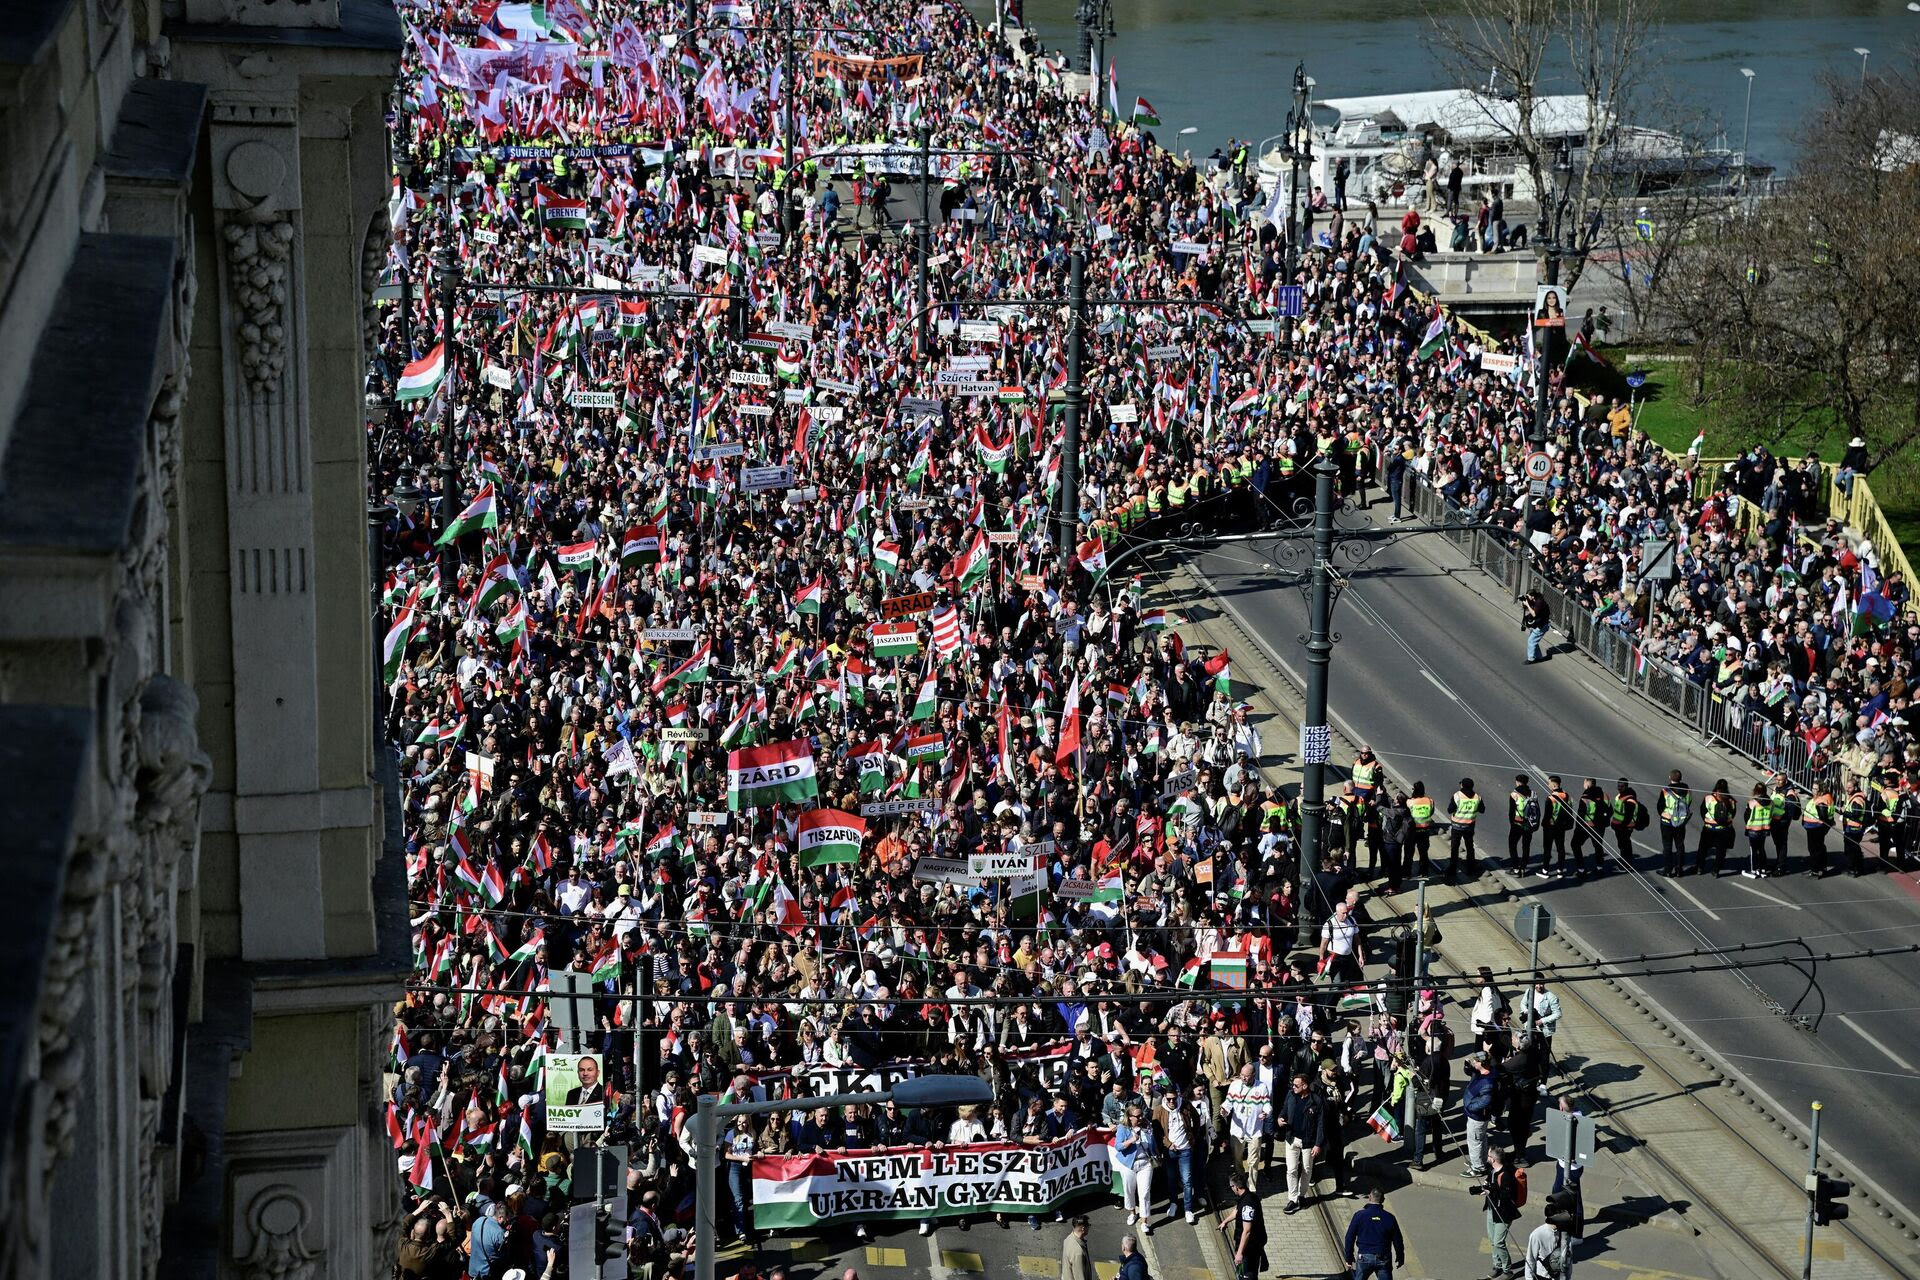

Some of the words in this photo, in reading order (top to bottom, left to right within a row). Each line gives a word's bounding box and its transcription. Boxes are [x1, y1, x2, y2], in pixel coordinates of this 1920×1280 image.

[548, 208, 579, 218] PERENYE
[747, 340, 778, 348] DOMONY
[1483, 357, 1513, 367] KISPEST
[961, 384, 995, 392] Hatvan
[1533, 460, 1546, 472] 40
[990, 533, 1016, 541] CSORNA
[882, 594, 934, 616] FARÁD
[876, 635, 913, 645] JÁSZAPÁTI
[1305, 725, 1331, 734] TISZA
[1305, 733, 1331, 742] TISZA
[1305, 741, 1331, 749] TISZA
[1305, 748, 1331, 757] TISZA
[1305, 756, 1331, 765] TISZA
[1166, 774, 1193, 794] TASS
[868, 801, 936, 813] CSEPREG
[1024, 844, 1050, 857] SZIL
[991, 857, 1028, 868] IVÁN
[548, 1108, 582, 1118] NAGY
[837, 1156, 922, 1183] NEM
[933, 1137, 1087, 1176] LESZÜNK
[809, 1182, 938, 1216] UKRÁN
[946, 1159, 1112, 1206] GYARMAT!
